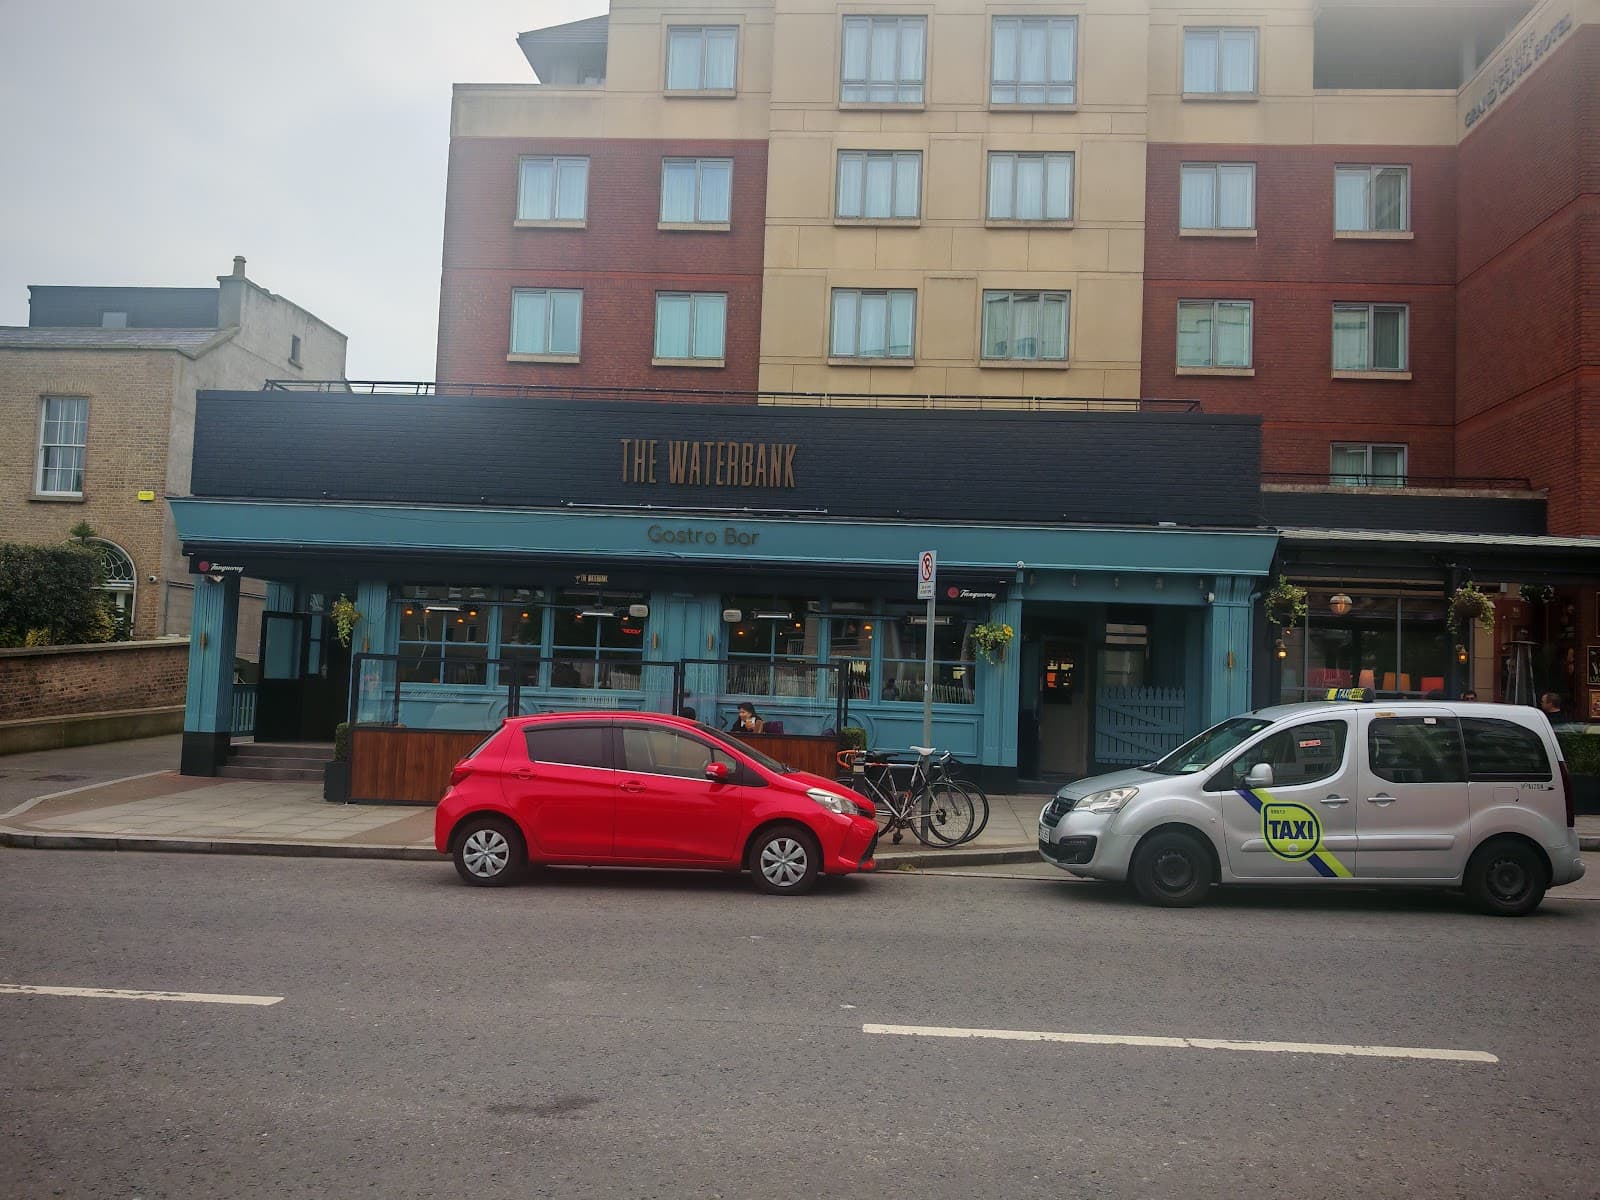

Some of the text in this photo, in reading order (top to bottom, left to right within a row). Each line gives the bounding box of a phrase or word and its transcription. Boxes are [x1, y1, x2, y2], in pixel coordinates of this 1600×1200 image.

[620, 439, 797, 488] THE WATERBANK
[647, 525, 761, 546] Gastro Bar
[1269, 820, 1314, 840] TAXI
